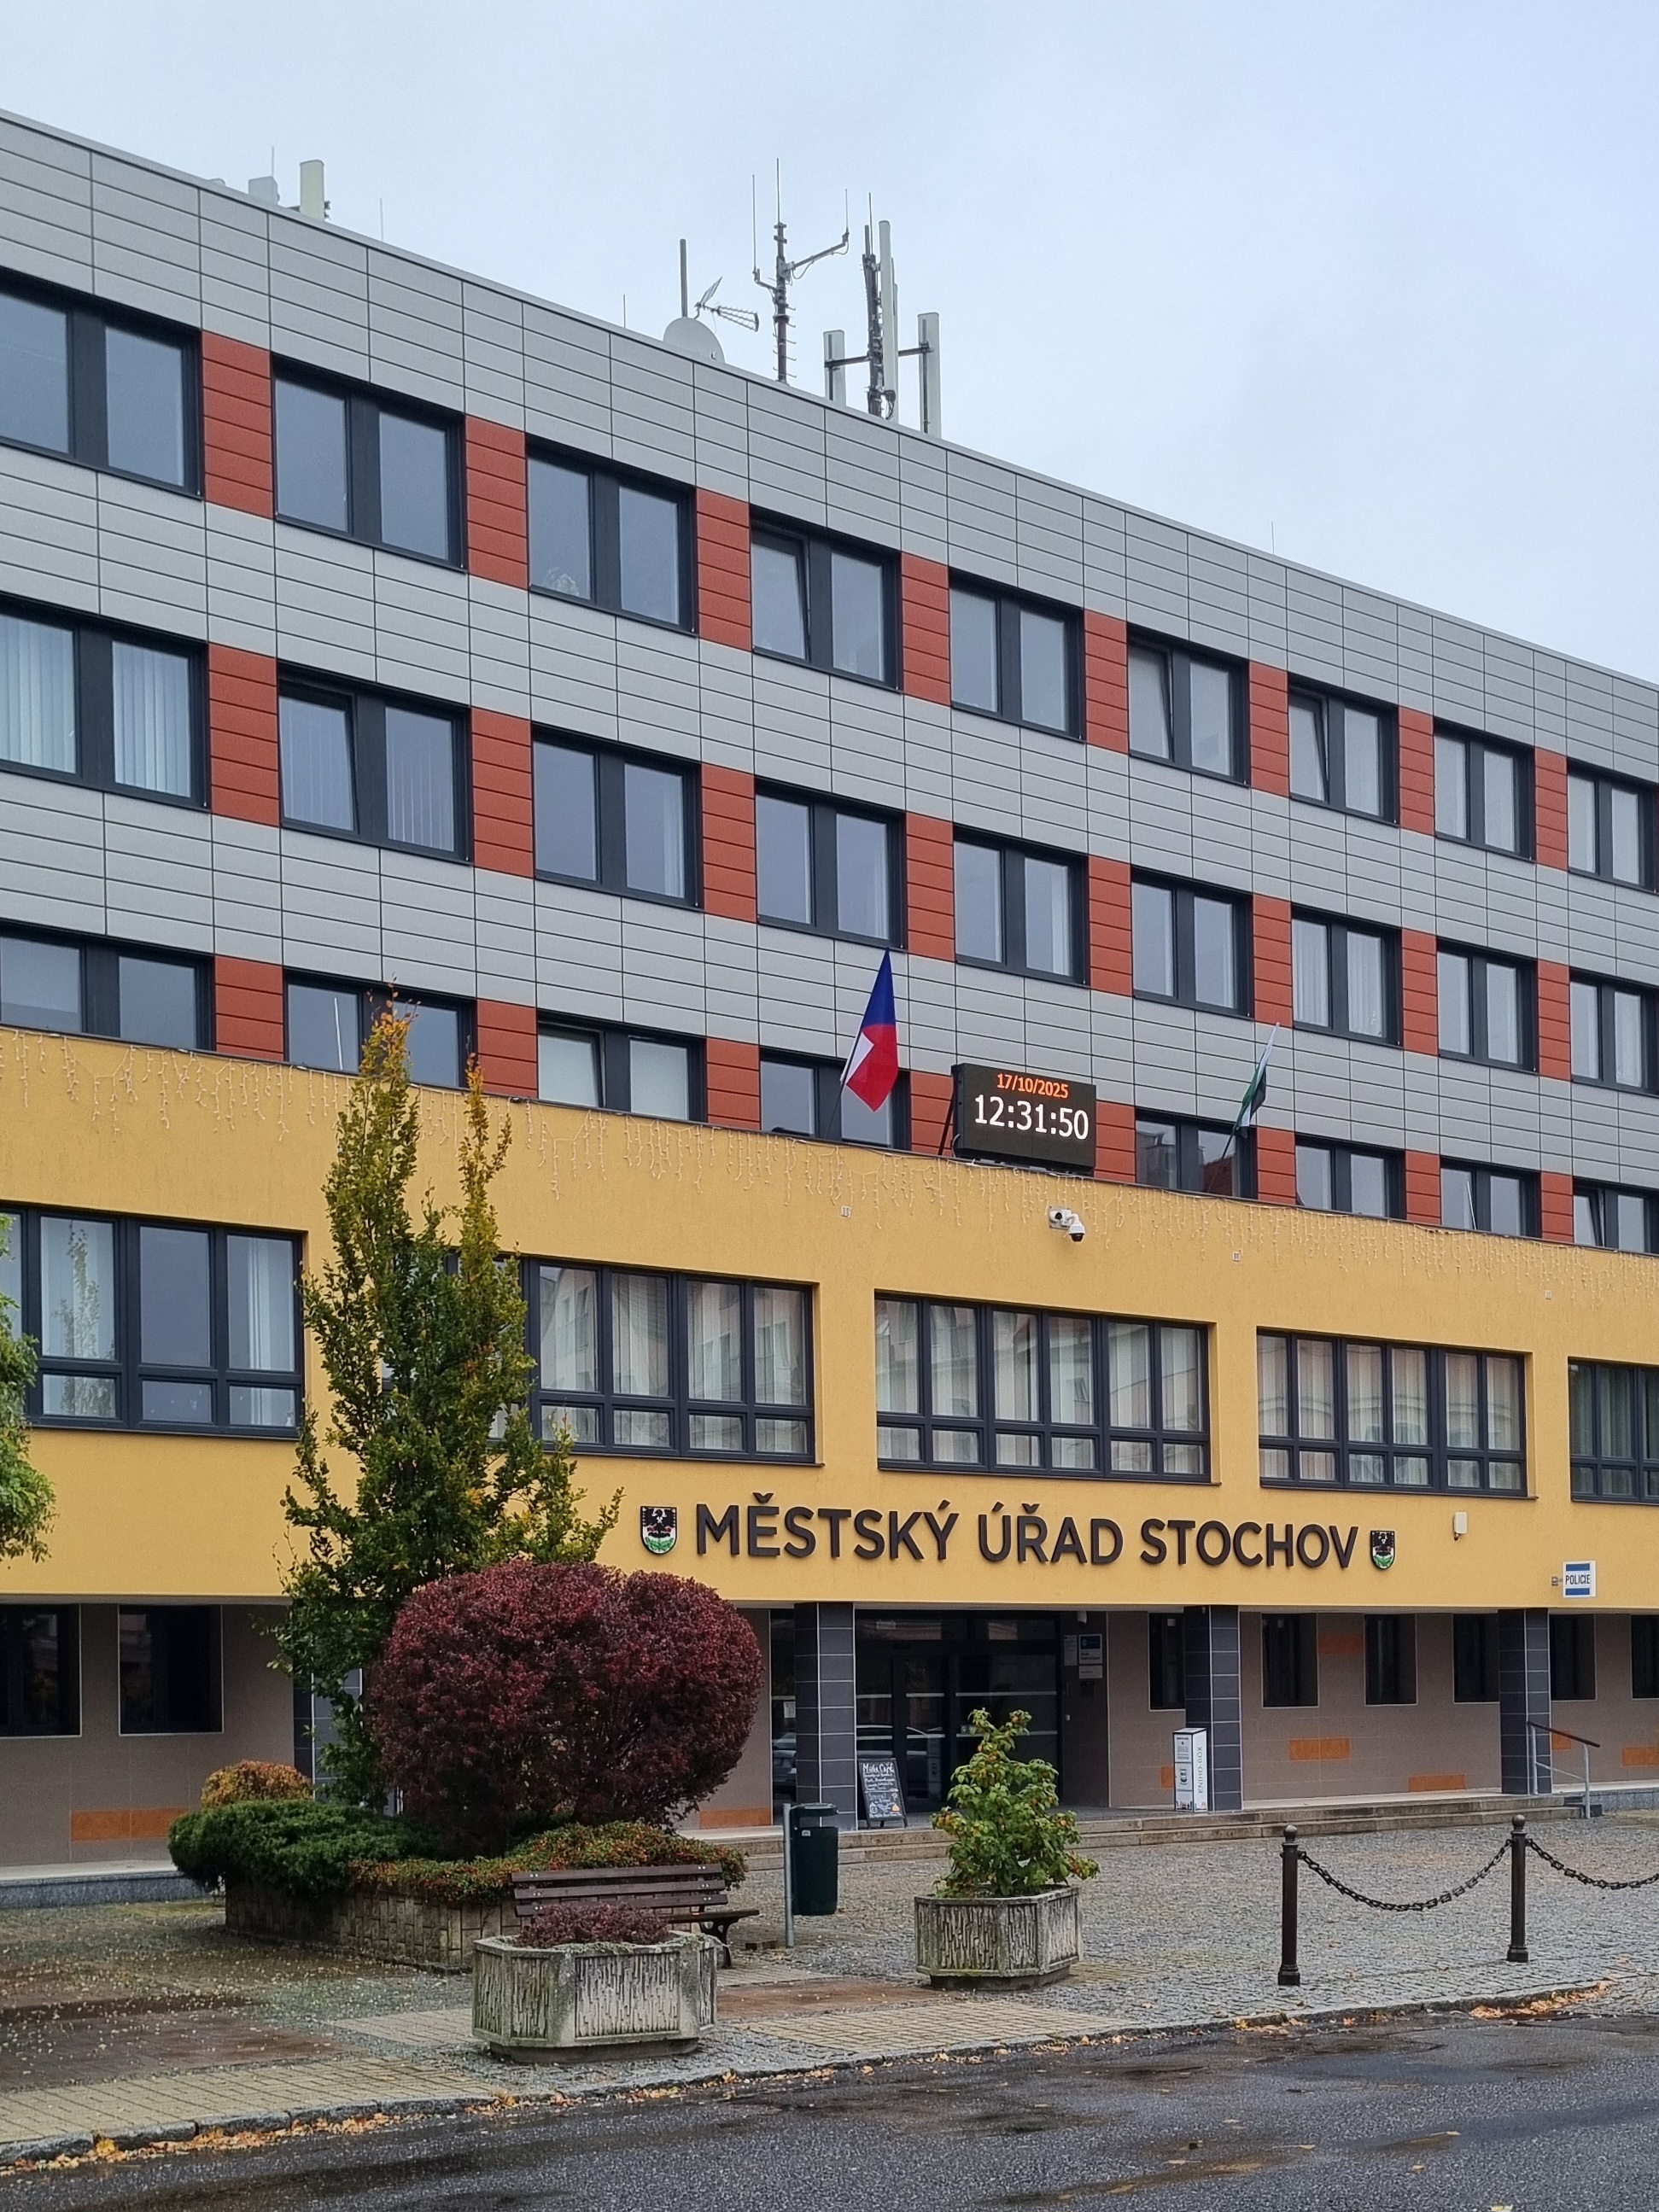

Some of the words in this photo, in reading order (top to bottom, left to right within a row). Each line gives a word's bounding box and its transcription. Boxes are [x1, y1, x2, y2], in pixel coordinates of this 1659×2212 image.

[997, 1073, 1068, 1099] 17/10/2025
[974, 1094, 1089, 1140] 12:31:50
[696, 1492, 960, 1560] MĚSTSKÝ
[978, 1502, 1124, 1564] ÚŘAD
[1140, 1518, 1358, 1568] STOCHOV
[1565, 1574, 1591, 1585] POLICIE
